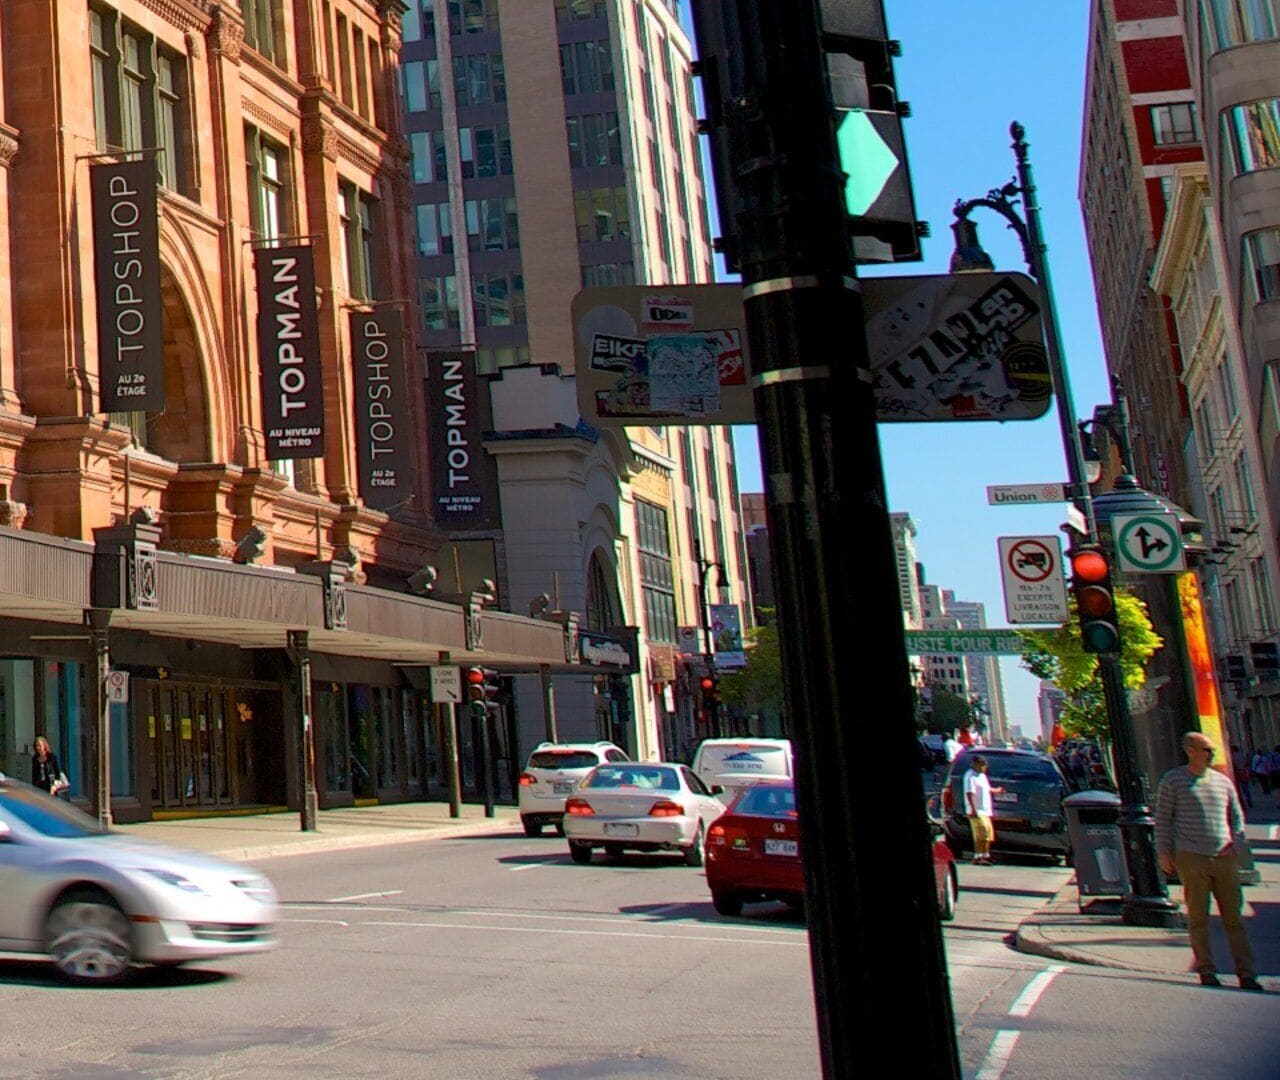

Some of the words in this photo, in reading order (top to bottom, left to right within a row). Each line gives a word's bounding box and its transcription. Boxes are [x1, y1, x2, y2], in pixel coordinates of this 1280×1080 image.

[109, 175, 144, 362] TOPSHOP
[272, 257, 307, 418] TOPMAN
[118, 375, 132, 384] AU
[132, 374, 145, 384] 2e
[117, 385, 146, 397] ÉTAGE
[364, 320, 394, 460] TOPSHOP
[442, 360, 470, 489] TOPMAN
[269, 428, 284, 438] AU
[284, 427, 321, 437] NIVEAU
[279, 437, 312, 448] MÉTRO
[371, 470, 383, 478] AU
[439, 496, 451, 504] AU
[451, 496, 481, 504] NIVEAU
[994, 491, 1038, 503] Union
[906, 636, 947, 652] USTE
[950, 636, 993, 652] POUR
